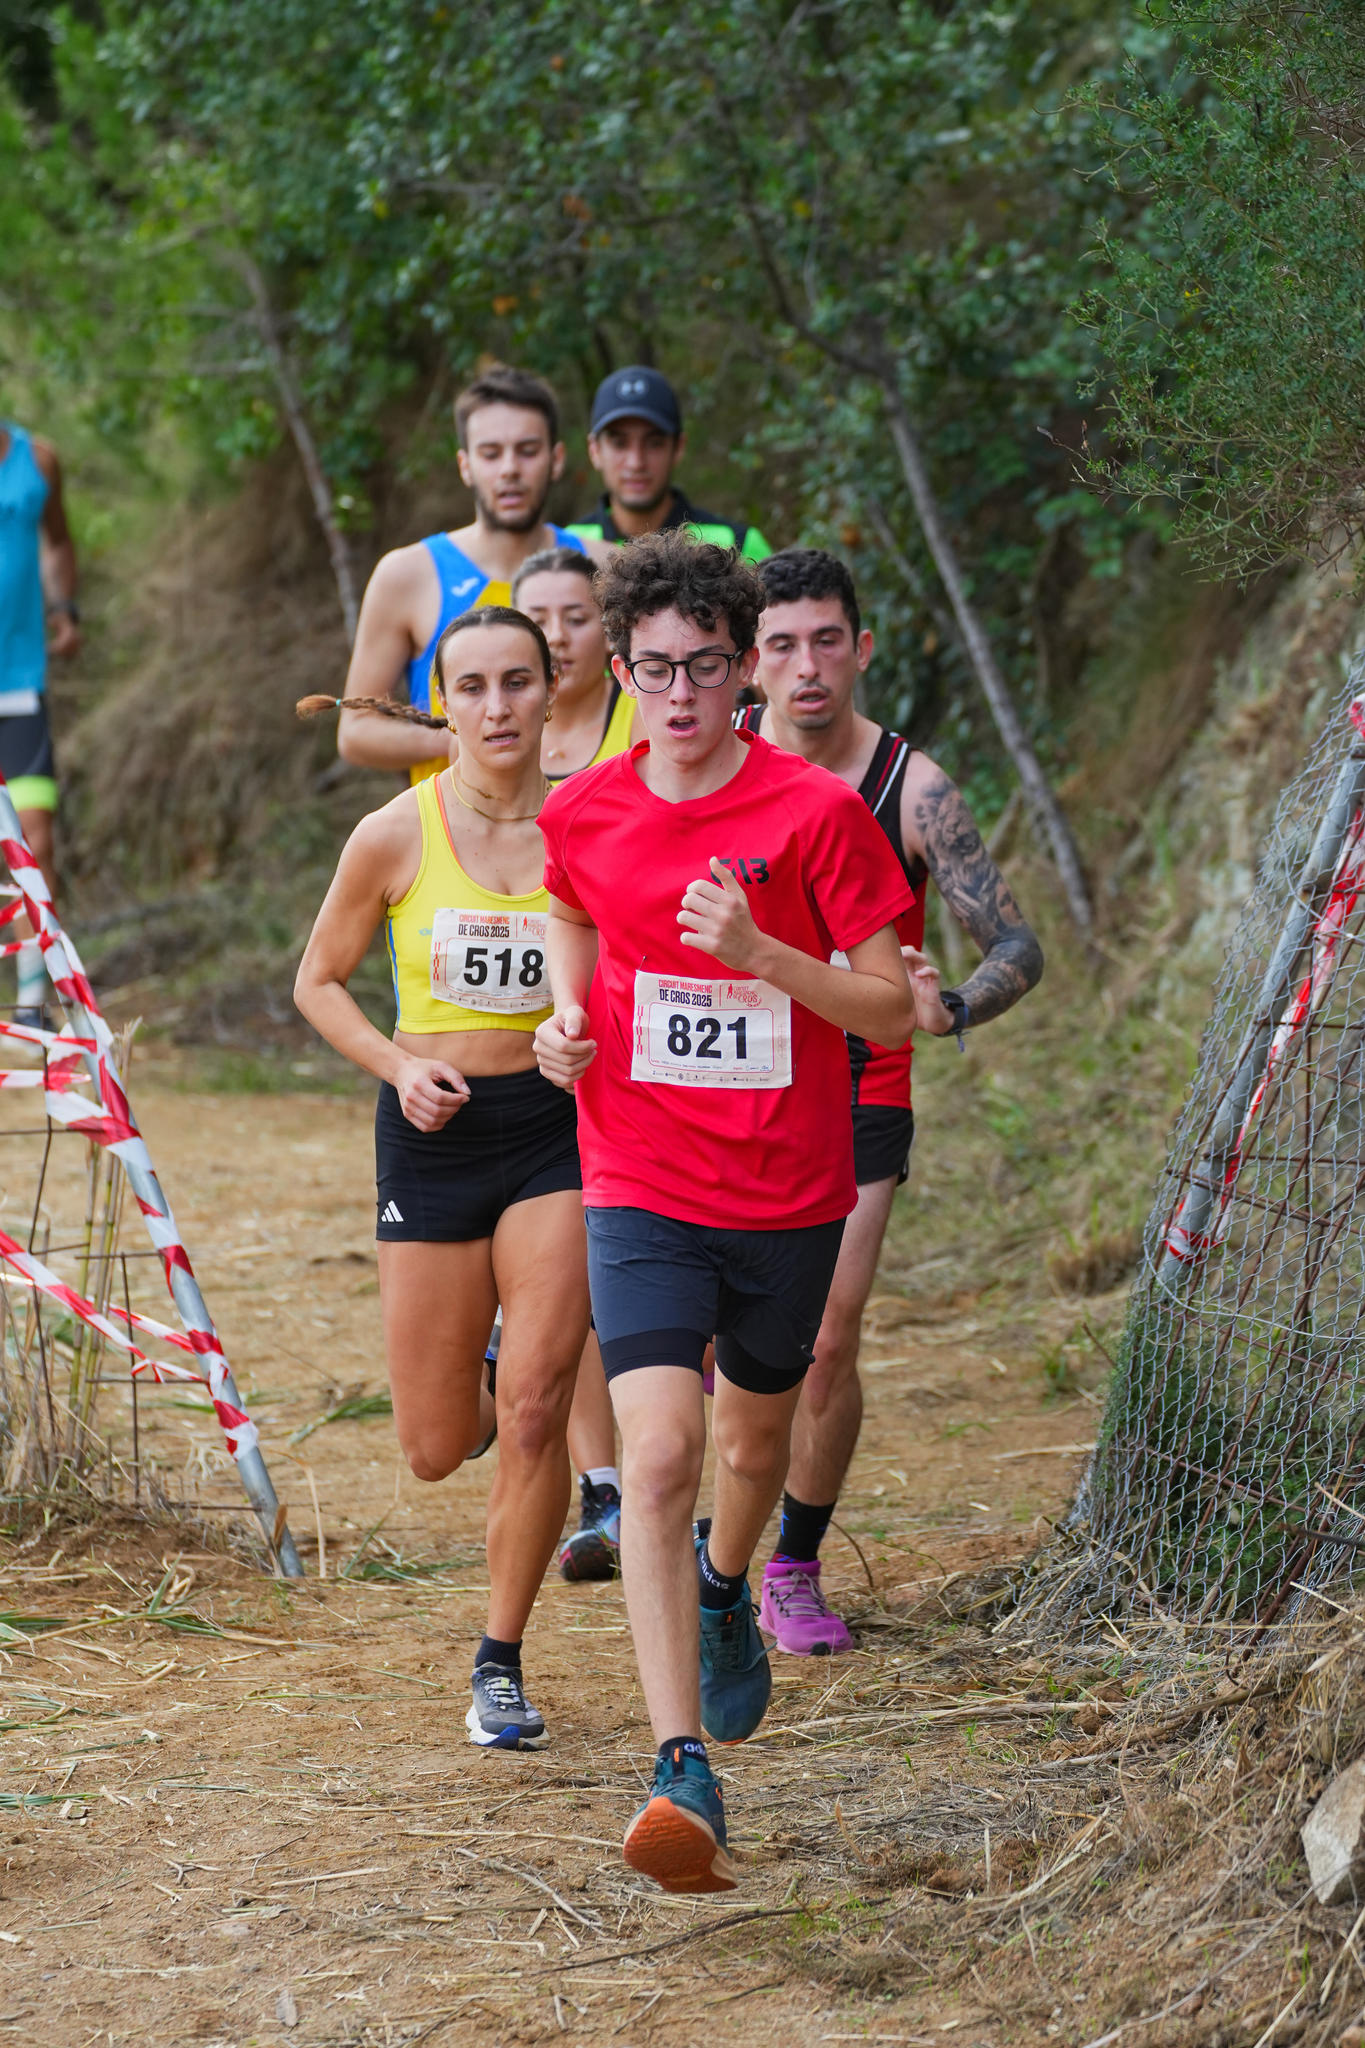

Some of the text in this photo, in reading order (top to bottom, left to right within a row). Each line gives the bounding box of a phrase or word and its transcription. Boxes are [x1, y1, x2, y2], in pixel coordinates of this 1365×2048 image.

[459, 914, 479, 923] CIRCUIT
[458, 924, 510, 938] DE CROS 2025
[464, 947, 544, 987] 518
[658, 979, 713, 994] CIRCUIT MARESMENC
[659, 988, 712, 1007] DE CROS 2025
[667, 1013, 747, 1060] 821
